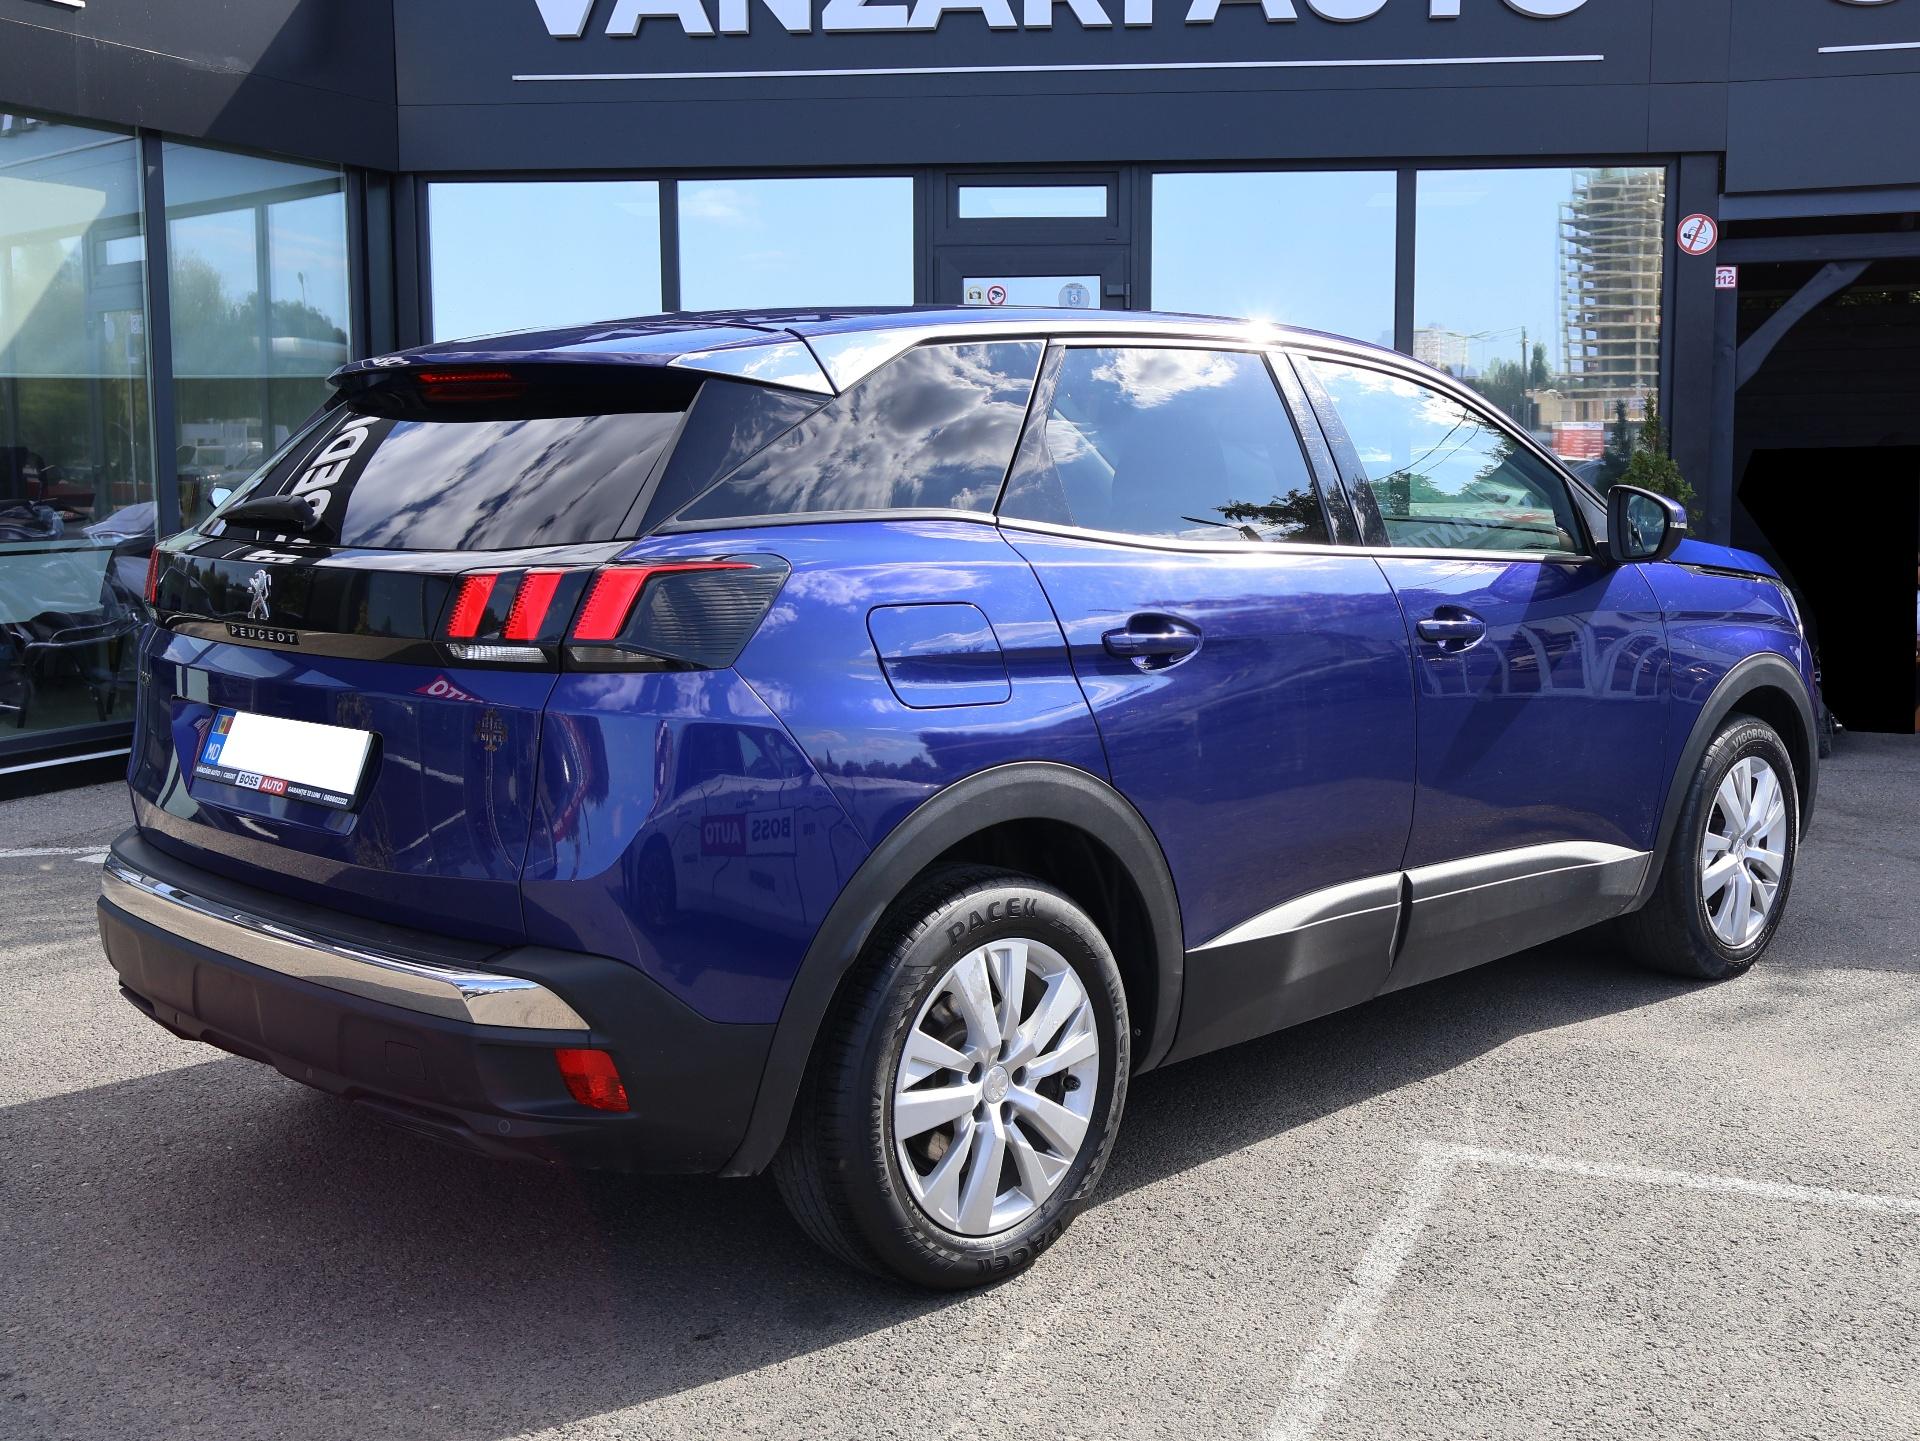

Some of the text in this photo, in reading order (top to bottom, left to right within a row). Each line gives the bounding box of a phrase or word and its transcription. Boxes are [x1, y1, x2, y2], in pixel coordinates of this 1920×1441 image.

[1716, 275, 1735, 285] 112
[231, 625, 296, 643] PEUGEOT
[1732, 728, 1773, 748] VIGOROUS
[205, 742, 221, 761] MD
[239, 773, 284, 792] BOSS AUTO
